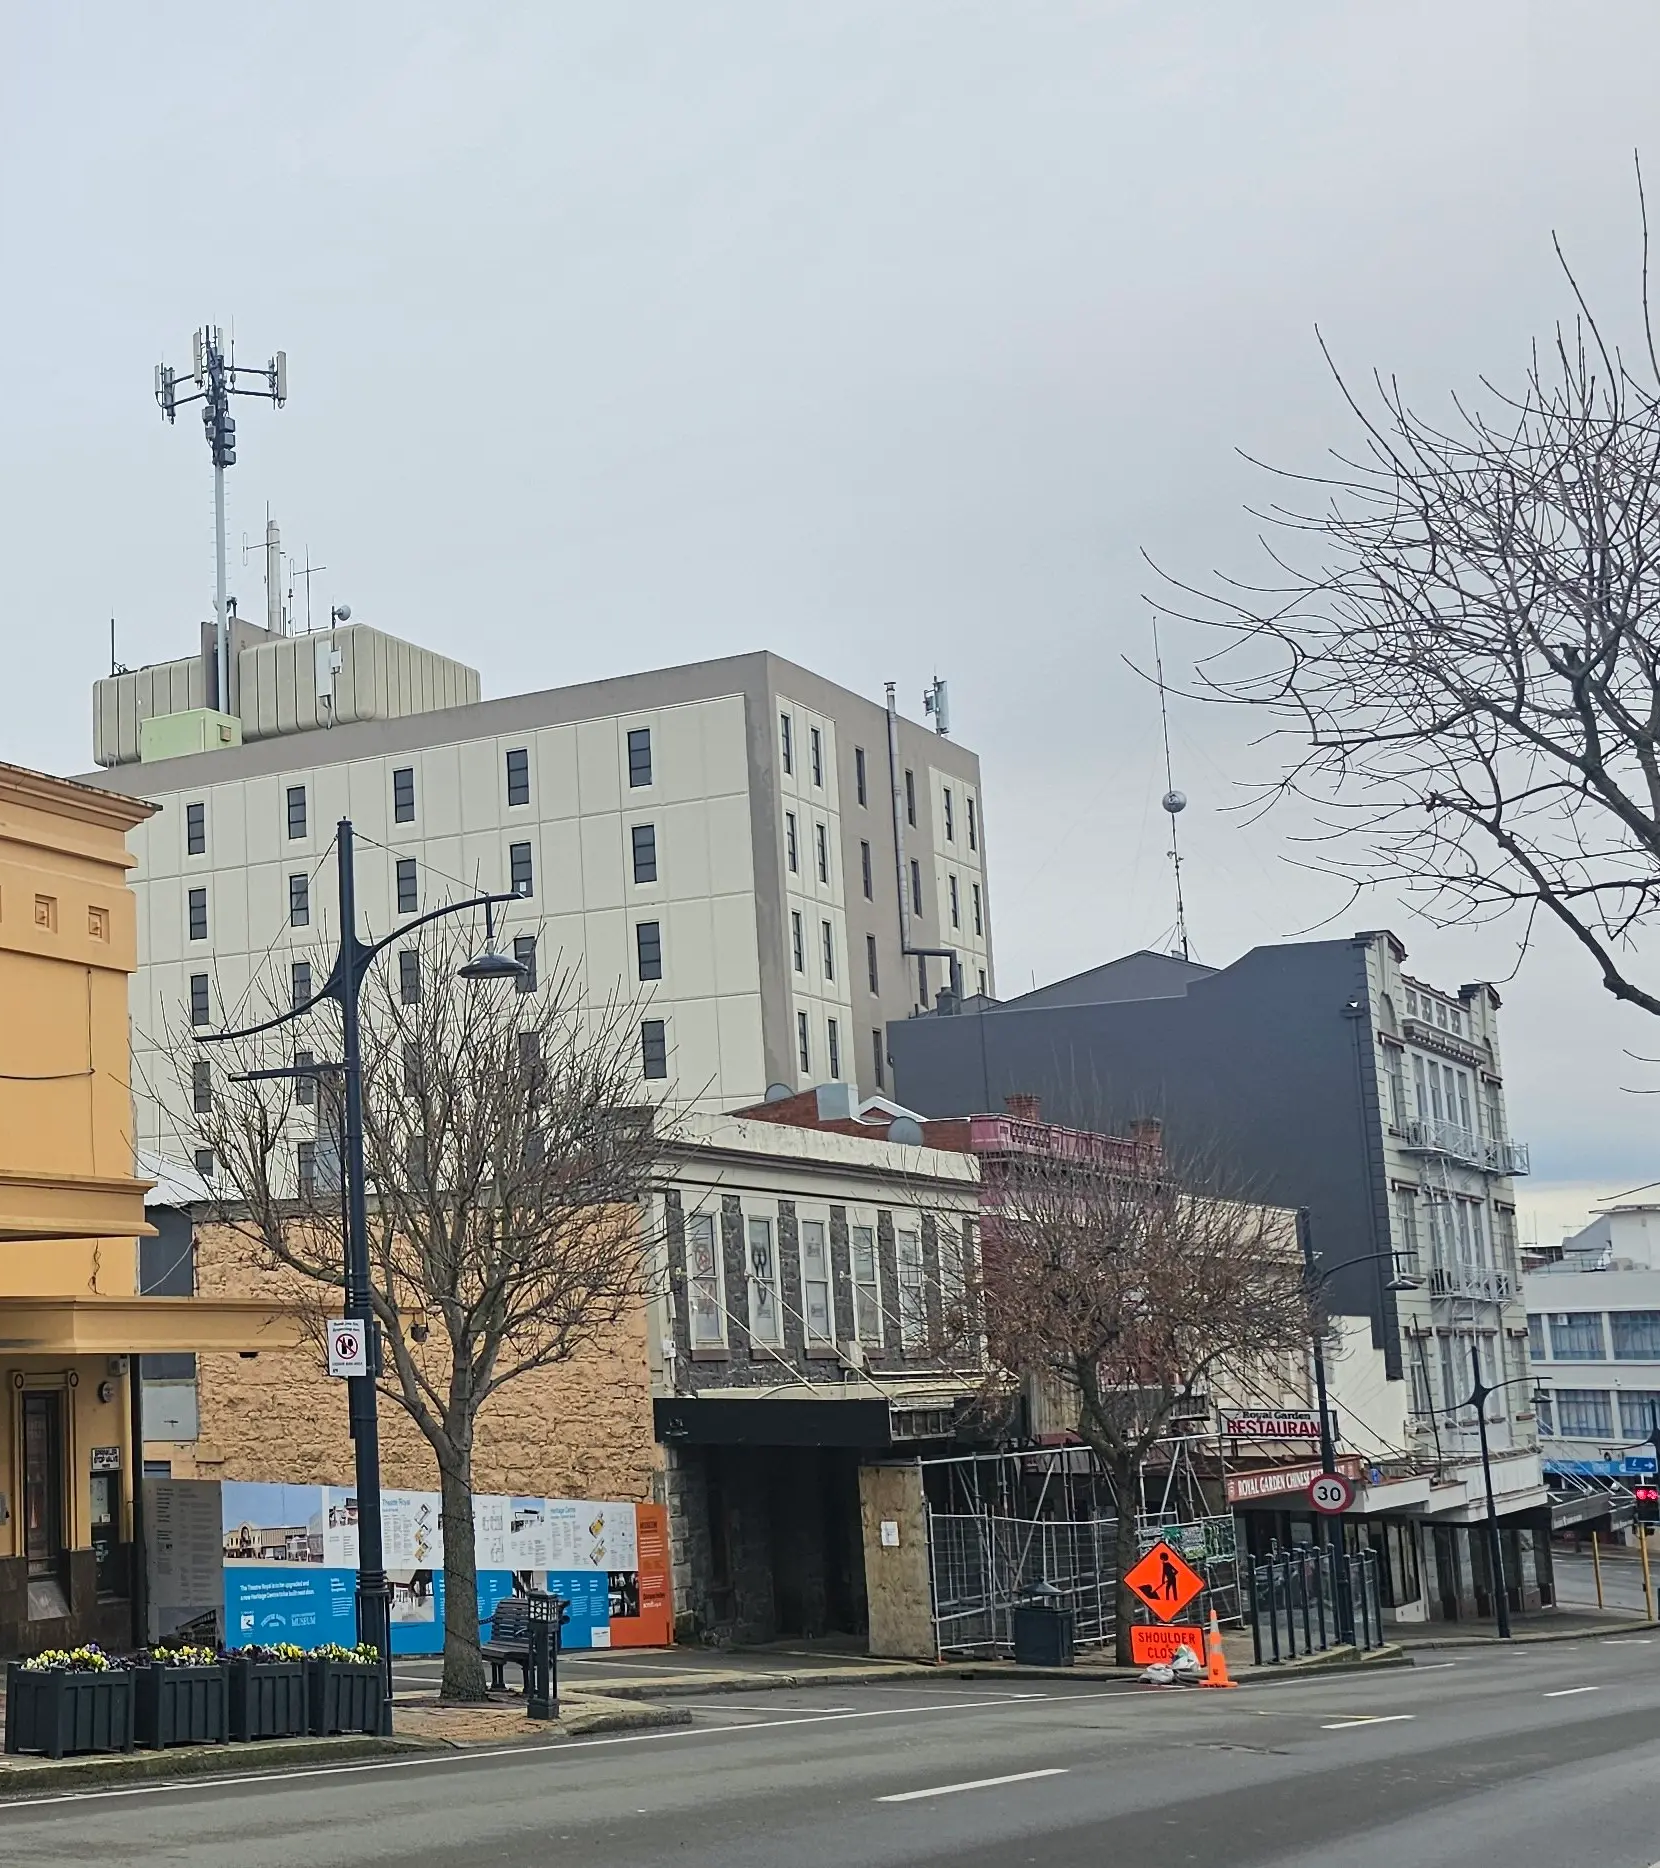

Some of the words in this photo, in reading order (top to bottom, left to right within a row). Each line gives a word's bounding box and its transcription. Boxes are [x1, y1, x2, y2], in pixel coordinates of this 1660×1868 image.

[1242, 1411, 1272, 1421] Royal
[1273, 1411, 1311, 1420] Garden
[1226, 1419, 1321, 1437] RESTAURAN
[1238, 1477, 1259, 1497] ROYAL
[1259, 1474, 1286, 1494] GARDEN
[1285, 1470, 1311, 1489] CHINESE
[1317, 1486, 1341, 1502] 30
[291, 1616, 316, 1627] MUSEUM
[1137, 1632, 1196, 1644] SHOULDER
[1147, 1646, 1178, 1659] CLOS
